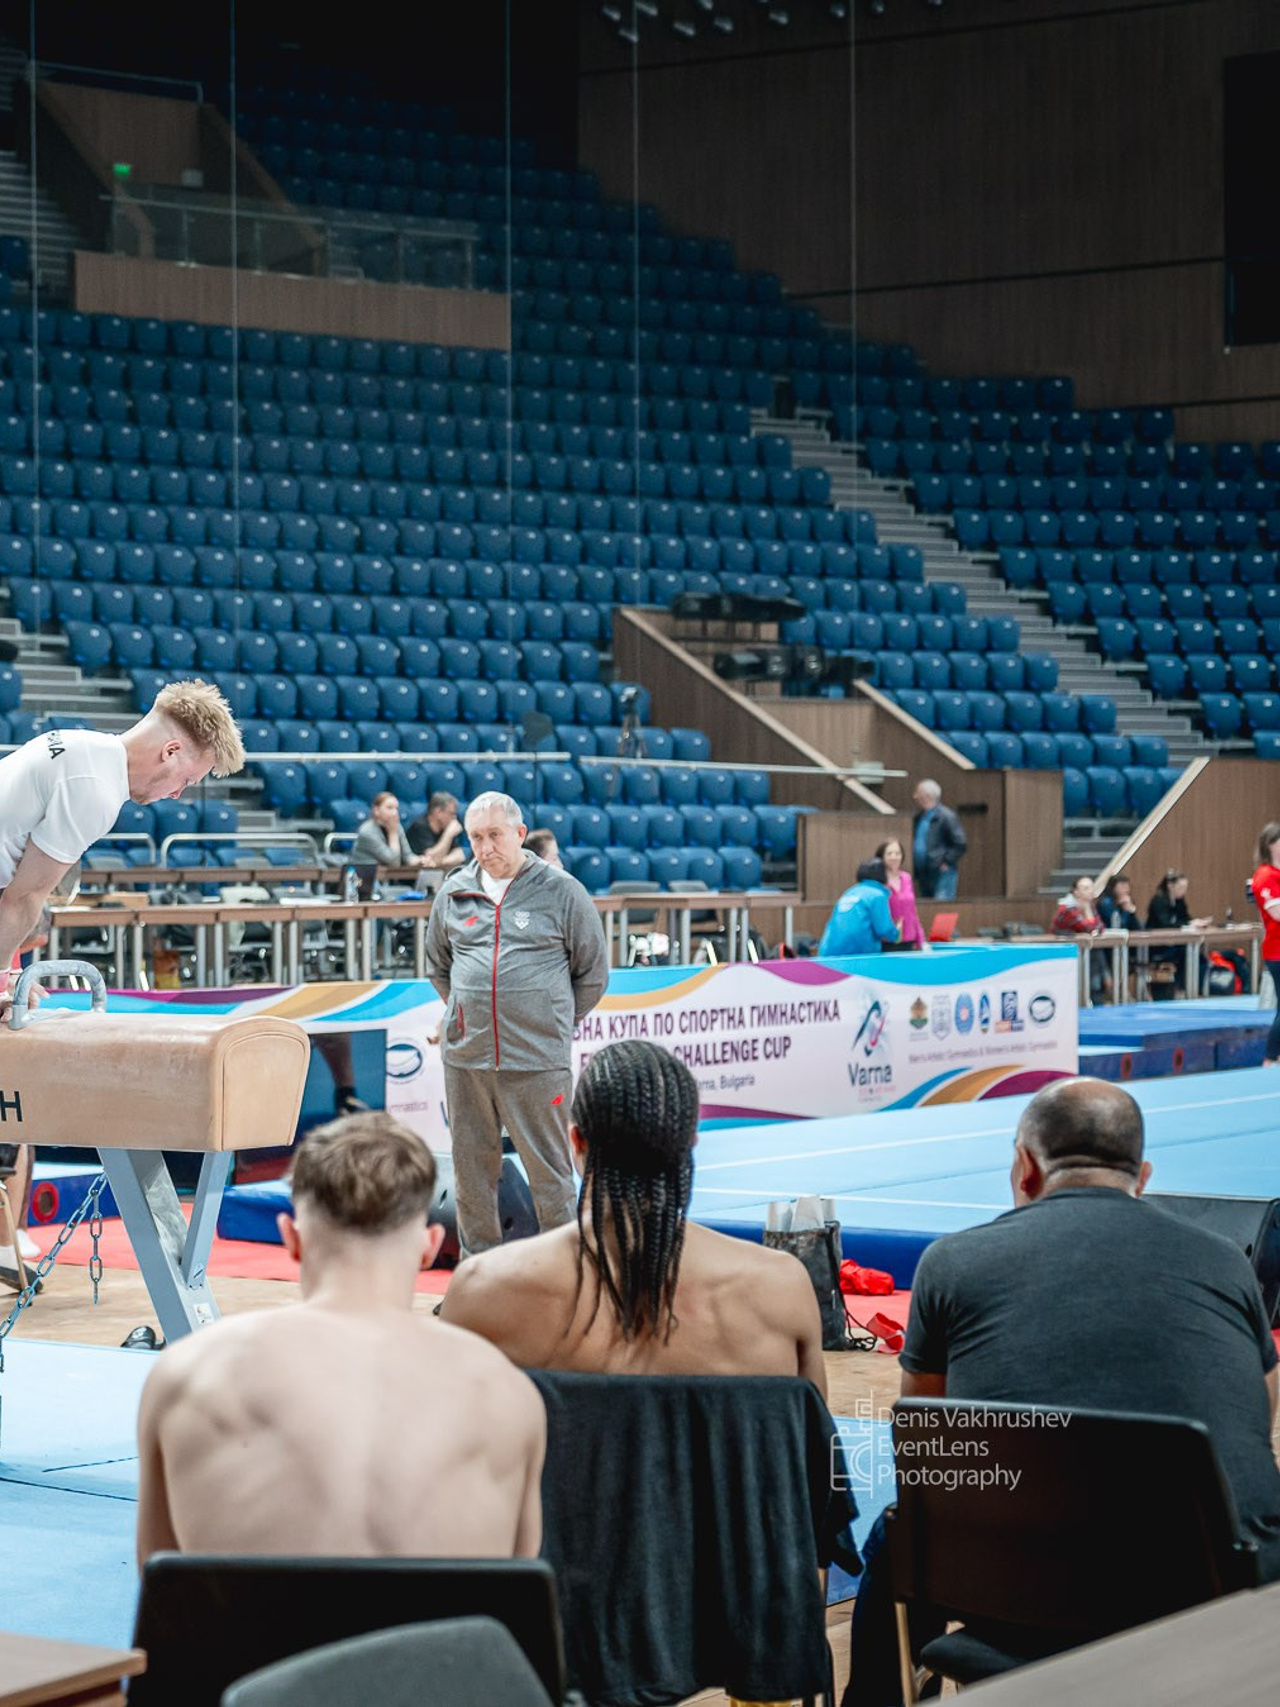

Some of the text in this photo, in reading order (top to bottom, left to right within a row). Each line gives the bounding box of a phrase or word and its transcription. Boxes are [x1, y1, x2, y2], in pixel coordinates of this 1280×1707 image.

[609, 1014, 649, 1039] КУПА
[653, 1012, 674, 1036] ПО
[679, 1006, 746, 1033] СПОРТНА
[750, 999, 841, 1028] ГИМНАСТИКА
[763, 1036, 792, 1060] CUP
[848, 1062, 892, 1087] Varna
